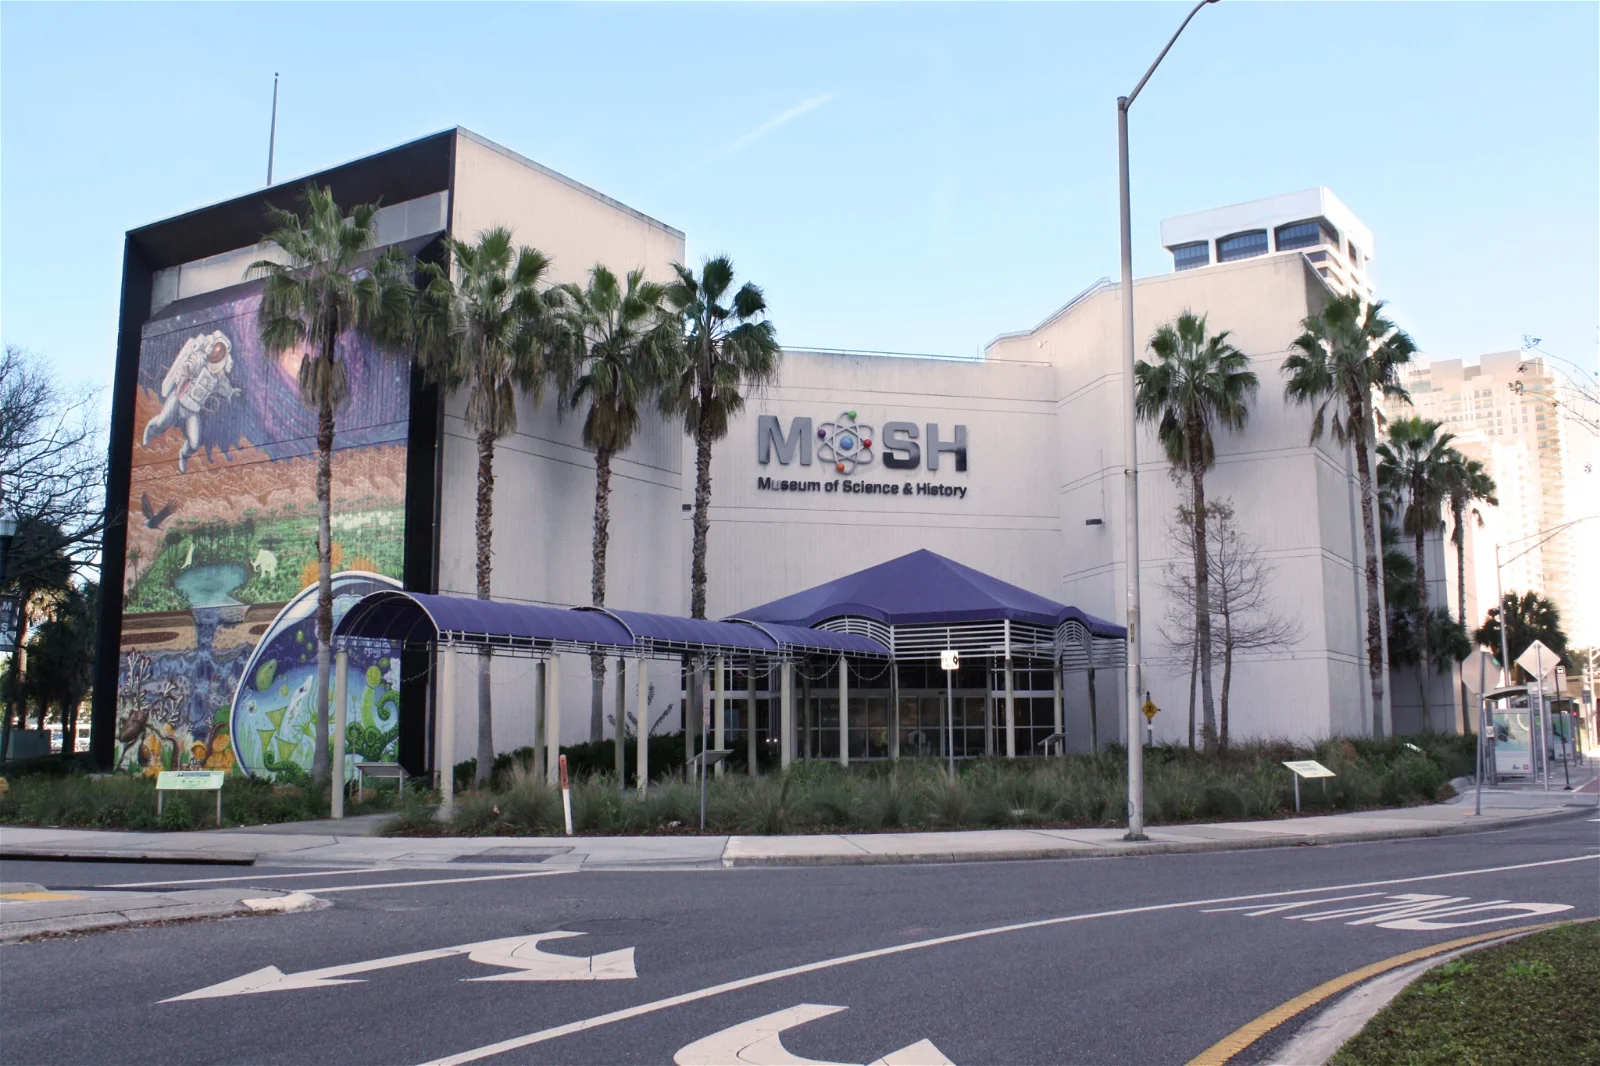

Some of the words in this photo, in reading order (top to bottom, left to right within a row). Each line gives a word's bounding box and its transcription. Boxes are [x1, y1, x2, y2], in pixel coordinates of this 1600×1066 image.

[757, 477, 821, 492] Museum
[824, 479, 839, 493] of
[842, 480, 899, 495] Science
[902, 483, 913, 495] &
[916, 483, 967, 499] History
[1199, 892, 1576, 931] ONLY
